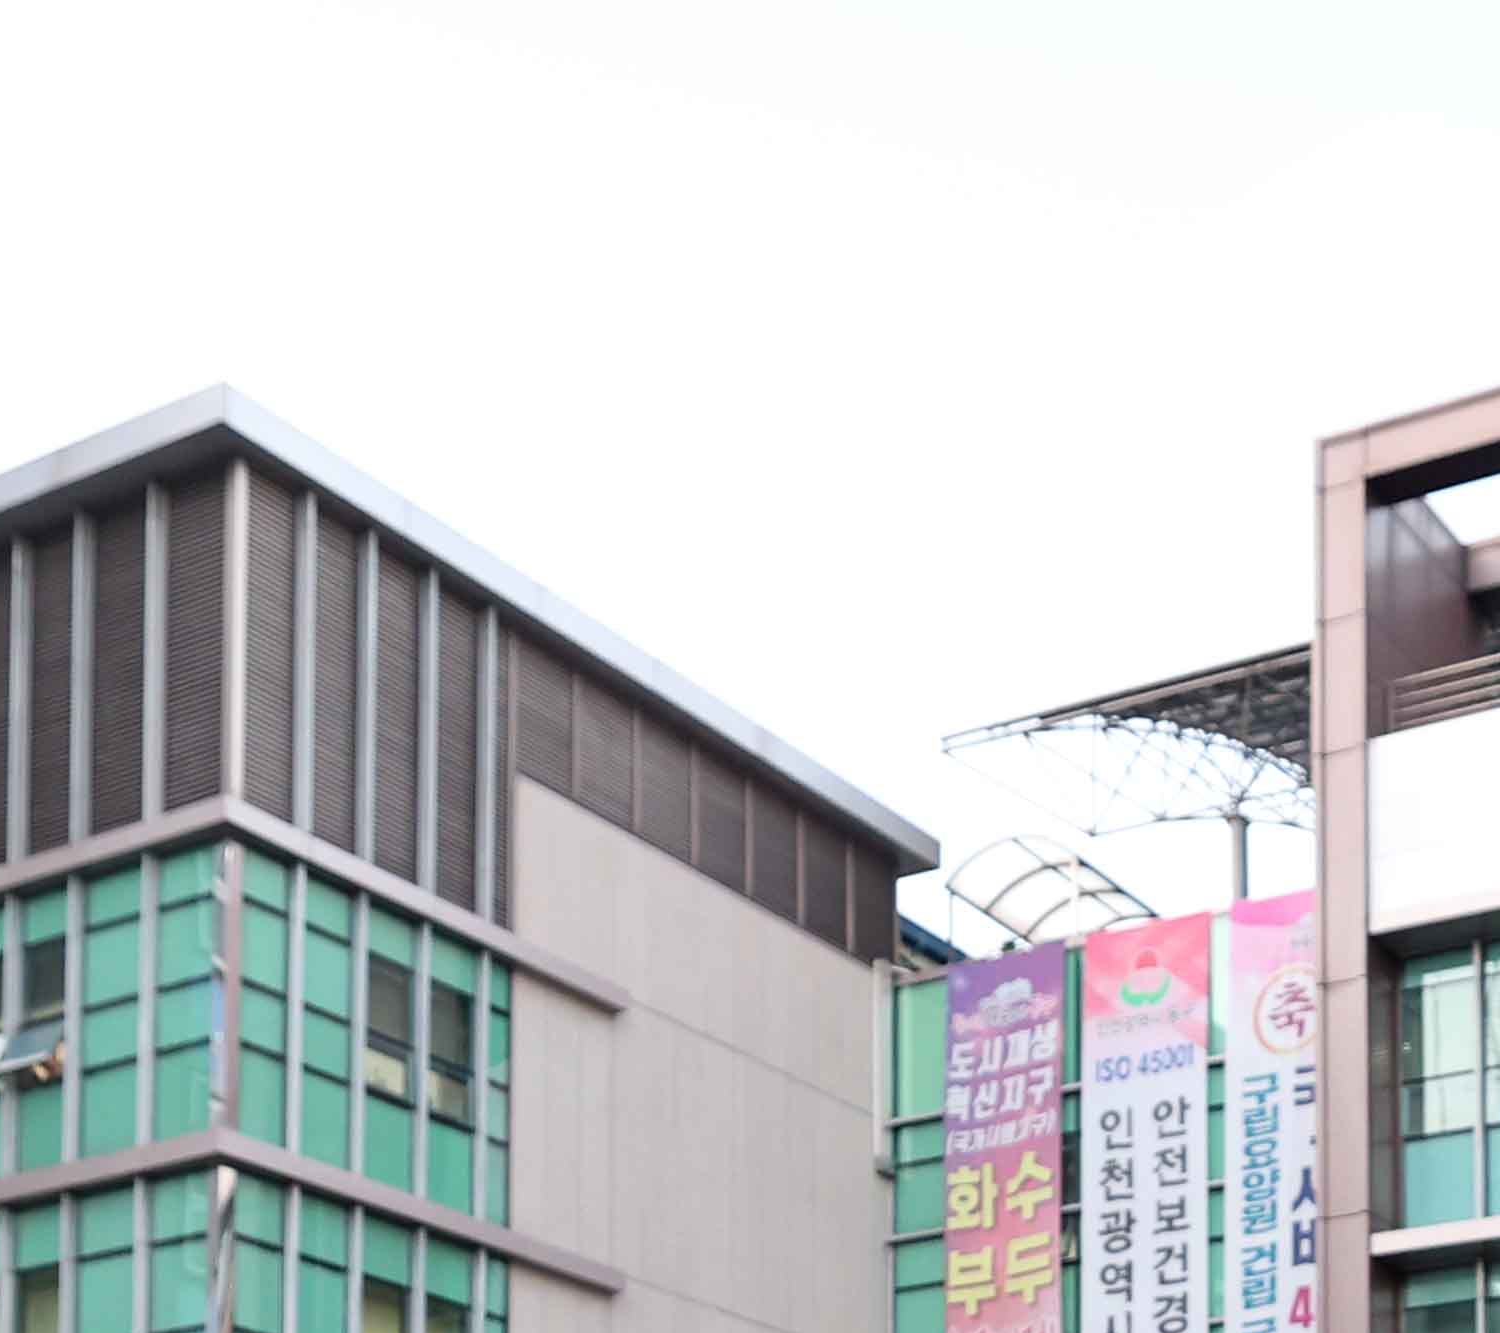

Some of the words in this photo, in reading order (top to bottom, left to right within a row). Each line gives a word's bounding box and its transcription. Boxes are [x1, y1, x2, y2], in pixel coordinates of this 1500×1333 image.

[1095, 1054, 1132, 1083] ISO
[1137, 1041, 1196, 1076] 45001
[947, 1151, 1054, 1233] 화수
[946, 1231, 1054, 1318] 부두
